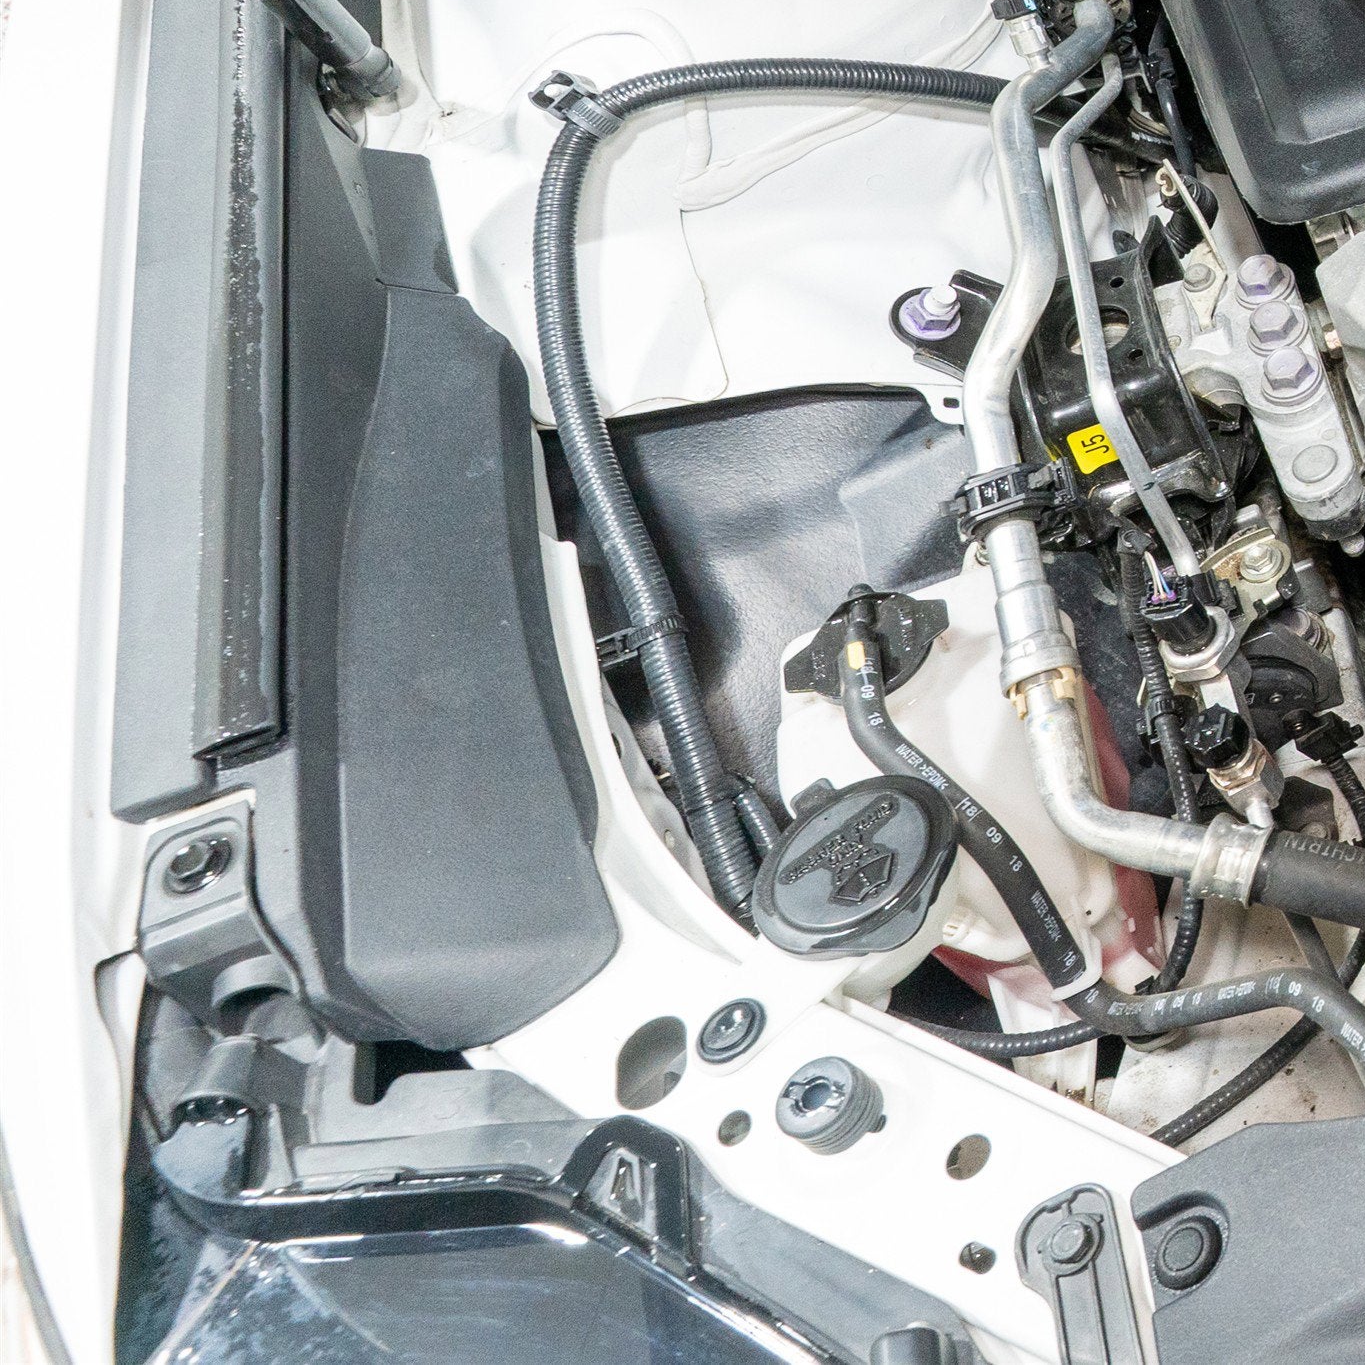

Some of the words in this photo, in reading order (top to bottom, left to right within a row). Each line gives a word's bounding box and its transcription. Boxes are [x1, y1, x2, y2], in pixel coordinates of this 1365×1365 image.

[1081, 434, 1110, 454] J5
[860, 685, 875, 699] 09
[868, 712, 884, 727] 18
[895, 743, 924, 770] WATER
[986, 826, 1003, 844] 09
[1009, 855, 1023, 872] 18
[1084, 988, 1099, 1004] 18
[1288, 981, 1301, 996] 09
[1311, 995, 1326, 1013] 18
[1340, 1022, 1364, 1051] WATER
